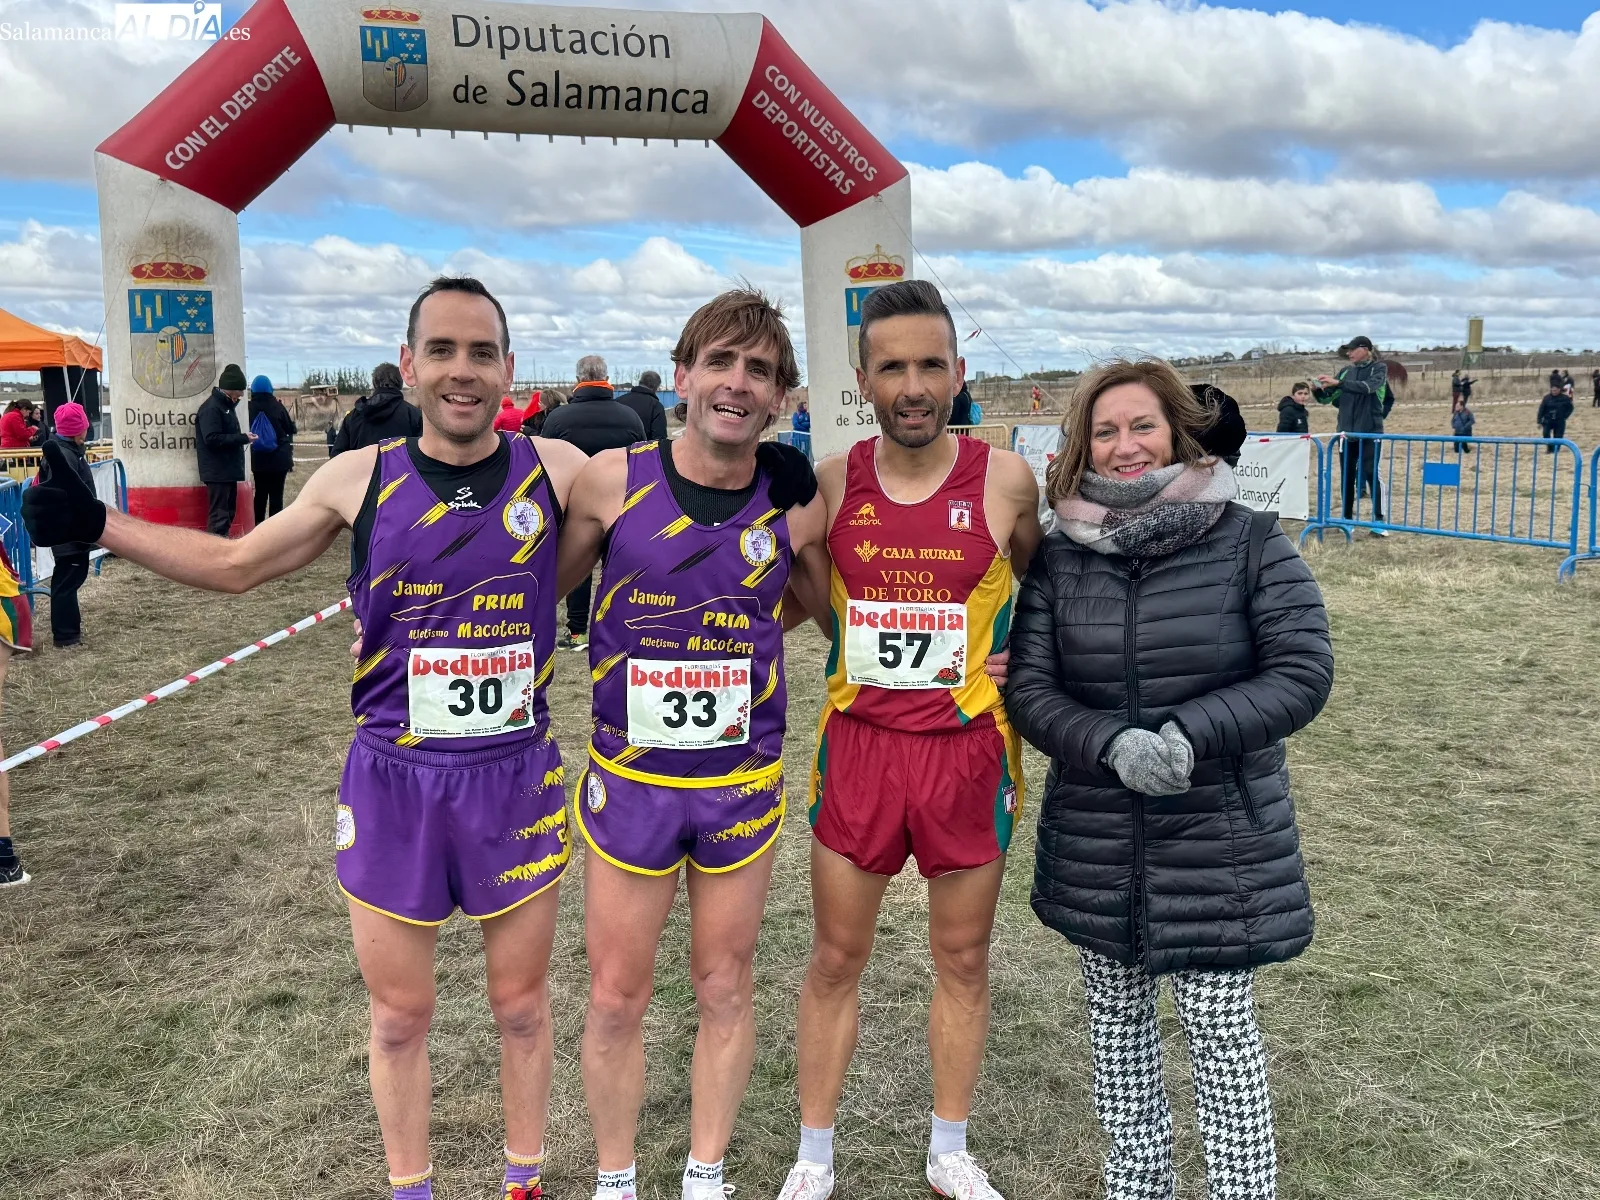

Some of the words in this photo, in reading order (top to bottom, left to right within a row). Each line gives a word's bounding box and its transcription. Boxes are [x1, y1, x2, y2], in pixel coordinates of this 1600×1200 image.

[451, 13, 671, 60] Diputación
[452, 75, 488, 104] de
[506, 69, 709, 114] Salamanca
[164, 130, 208, 170] CON
[199, 115, 230, 140] EL
[220, 45, 302, 121] DEPORTE
[764, 65, 802, 104] CON
[797, 98, 878, 182] NUESTROS
[751, 89, 856, 195] DEPORTISTAS
[836, 414, 850, 427] de
[121, 434, 133, 449] de
[139, 431, 197, 450] Salam
[882, 547, 916, 560] CAJA
[918, 547, 965, 561] RURAL
[880, 569, 934, 585] VINO
[392, 580, 444, 597] Jamón
[628, 588, 677, 607] Jamón
[863, 586, 889, 601] DE
[893, 587, 952, 603] TORO
[472, 592, 525, 612] PRIM
[456, 619, 531, 639] Macotera
[702, 610, 750, 630] PRIM
[849, 605, 964, 631] bedunia
[686, 635, 755, 655] Macotera
[878, 631, 932, 669] 57
[412, 650, 533, 677] bedunia
[630, 664, 748, 689] bedunia
[447, 677, 503, 717] 30
[662, 690, 717, 729] 33
